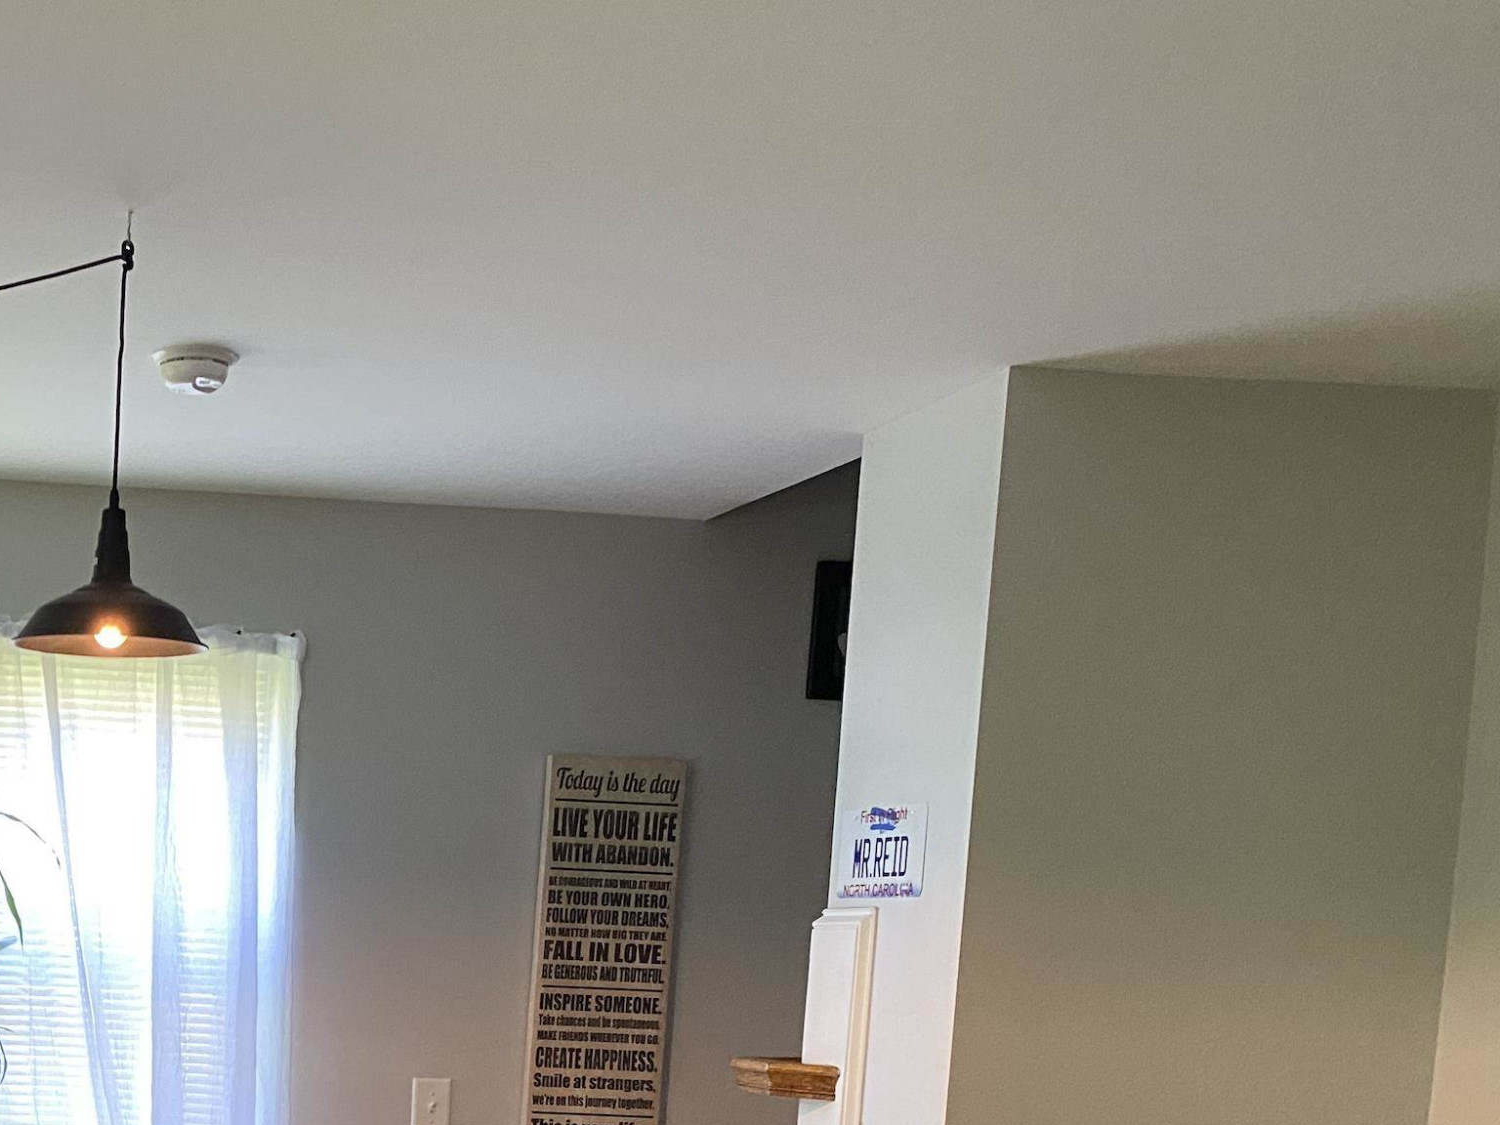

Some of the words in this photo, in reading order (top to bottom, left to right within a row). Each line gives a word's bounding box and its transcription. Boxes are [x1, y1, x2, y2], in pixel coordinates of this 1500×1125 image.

[557, 767, 604, 798] Today
[607, 771, 618, 792] is
[623, 772, 646, 793] the
[650, 774, 680, 802] day
[553, 807, 588, 838] LIVE
[594, 809, 640, 840] YOUR
[644, 812, 678, 842] LIFE
[552, 842, 593, 863] WITH
[596, 844, 674, 867] ABANDON.
[852, 836, 909, 878] MR.REID
[548, 890, 563, 904] BE
[566, 891, 598, 906] YOUR
[602, 892, 632, 908] OWN
[634, 894, 670, 910] HERO.
[843, 884, 870, 898] NORTH
[546, 908, 588, 924] FOLLOW
[590, 910, 619, 926] YOUR
[545, 927, 556, 936] NO
[558, 928, 589, 938] MATTER
[591, 928, 611, 939] HOW
[612, 930, 626, 940] BIG
[629, 930, 649, 940] THEY
[543, 940, 584, 961] FALL
[589, 942, 610, 962] IN
[614, 943, 666, 964] LOVE.
[542, 964, 554, 979] BE
[554, 964, 598, 981] GENEROUS
[600, 966, 618, 982] AND
[540, 993, 592, 1012] INSPIRE
[594, 995, 662, 1014] SOMEONE.
[539, 1014, 556, 1026] Take
[537, 1030, 556, 1040] MAKE
[558, 1031, 588, 1042] FRIENDS
[590, 1032, 630, 1044] WHEREVER
[631, 1034, 646, 1044] YOU
[536, 1046, 582, 1069] CREATE
[584, 1048, 658, 1073] HAPPINESS.
[534, 1072, 570, 1088] Smile
[573, 1075, 586, 1089] at
[589, 1076, 656, 1093] strangers,
[532, 1093, 555, 1106] we're
[556, 1096, 567, 1106] on
[568, 1095, 584, 1107] this
[585, 1096, 617, 1110] journey
